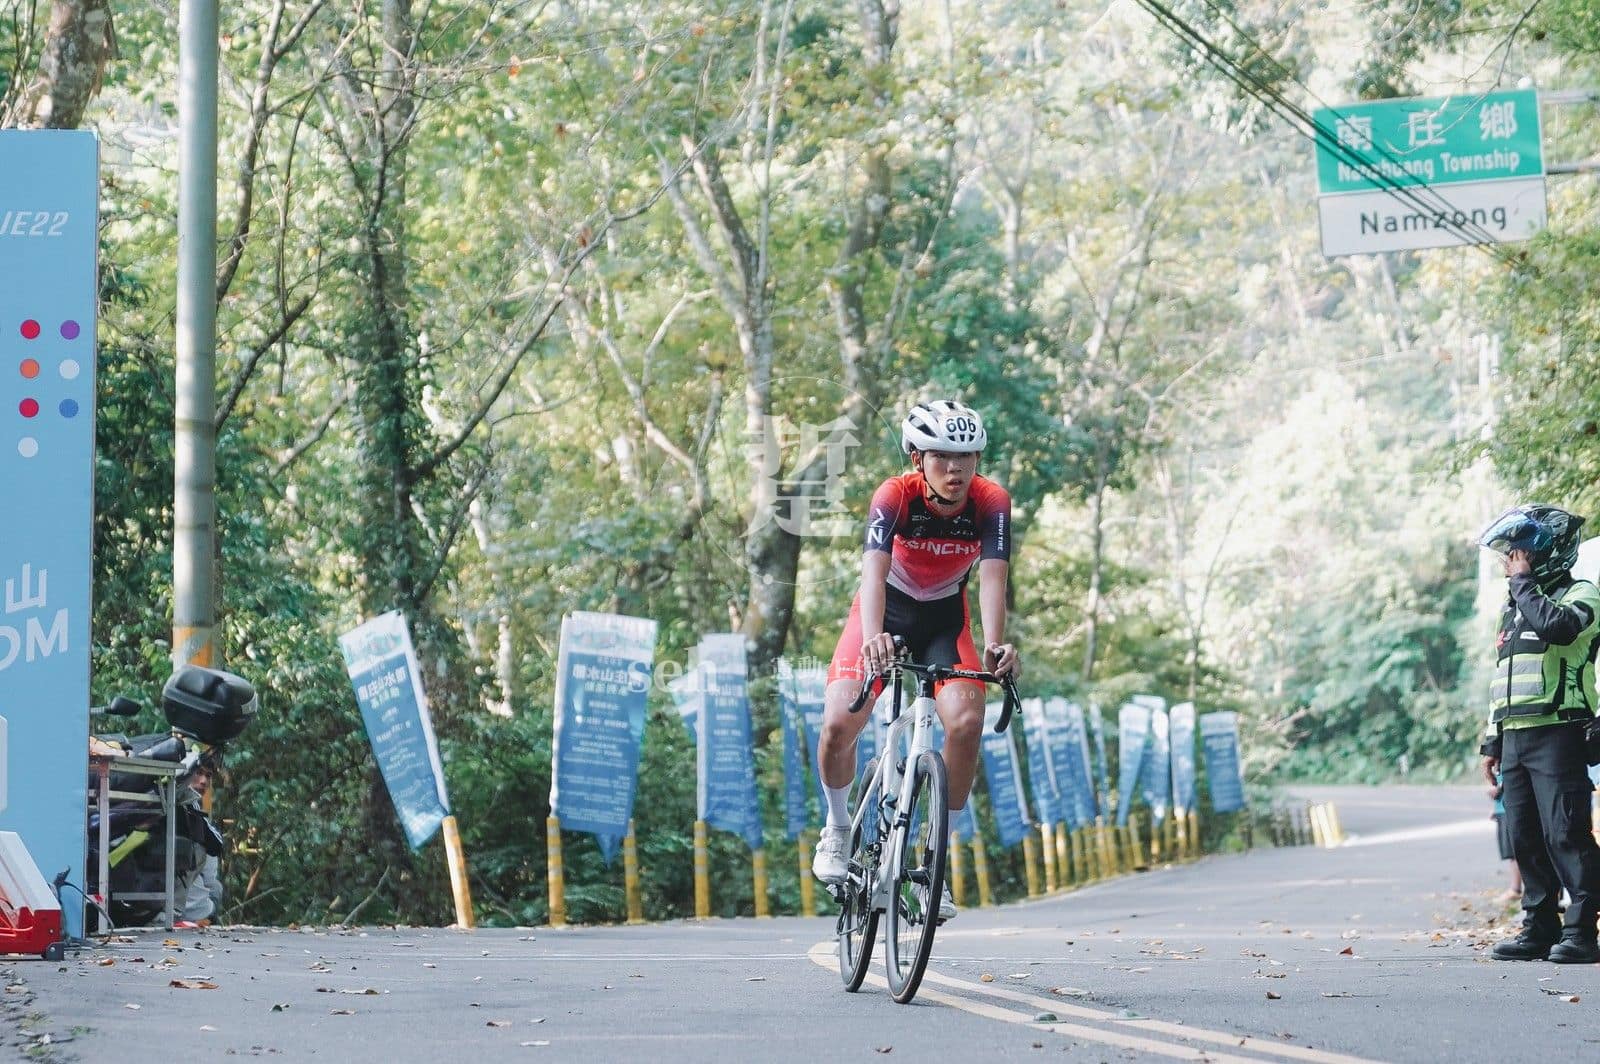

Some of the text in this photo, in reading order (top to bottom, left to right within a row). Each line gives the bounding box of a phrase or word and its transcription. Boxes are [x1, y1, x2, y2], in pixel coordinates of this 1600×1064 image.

[1335, 101, 1518, 150] 南庄鄉
[1440, 147, 1520, 172] Township
[1360, 206, 1507, 235] Namzong
[946, 416, 976, 433] 606
[5, 562, 48, 614] 山
